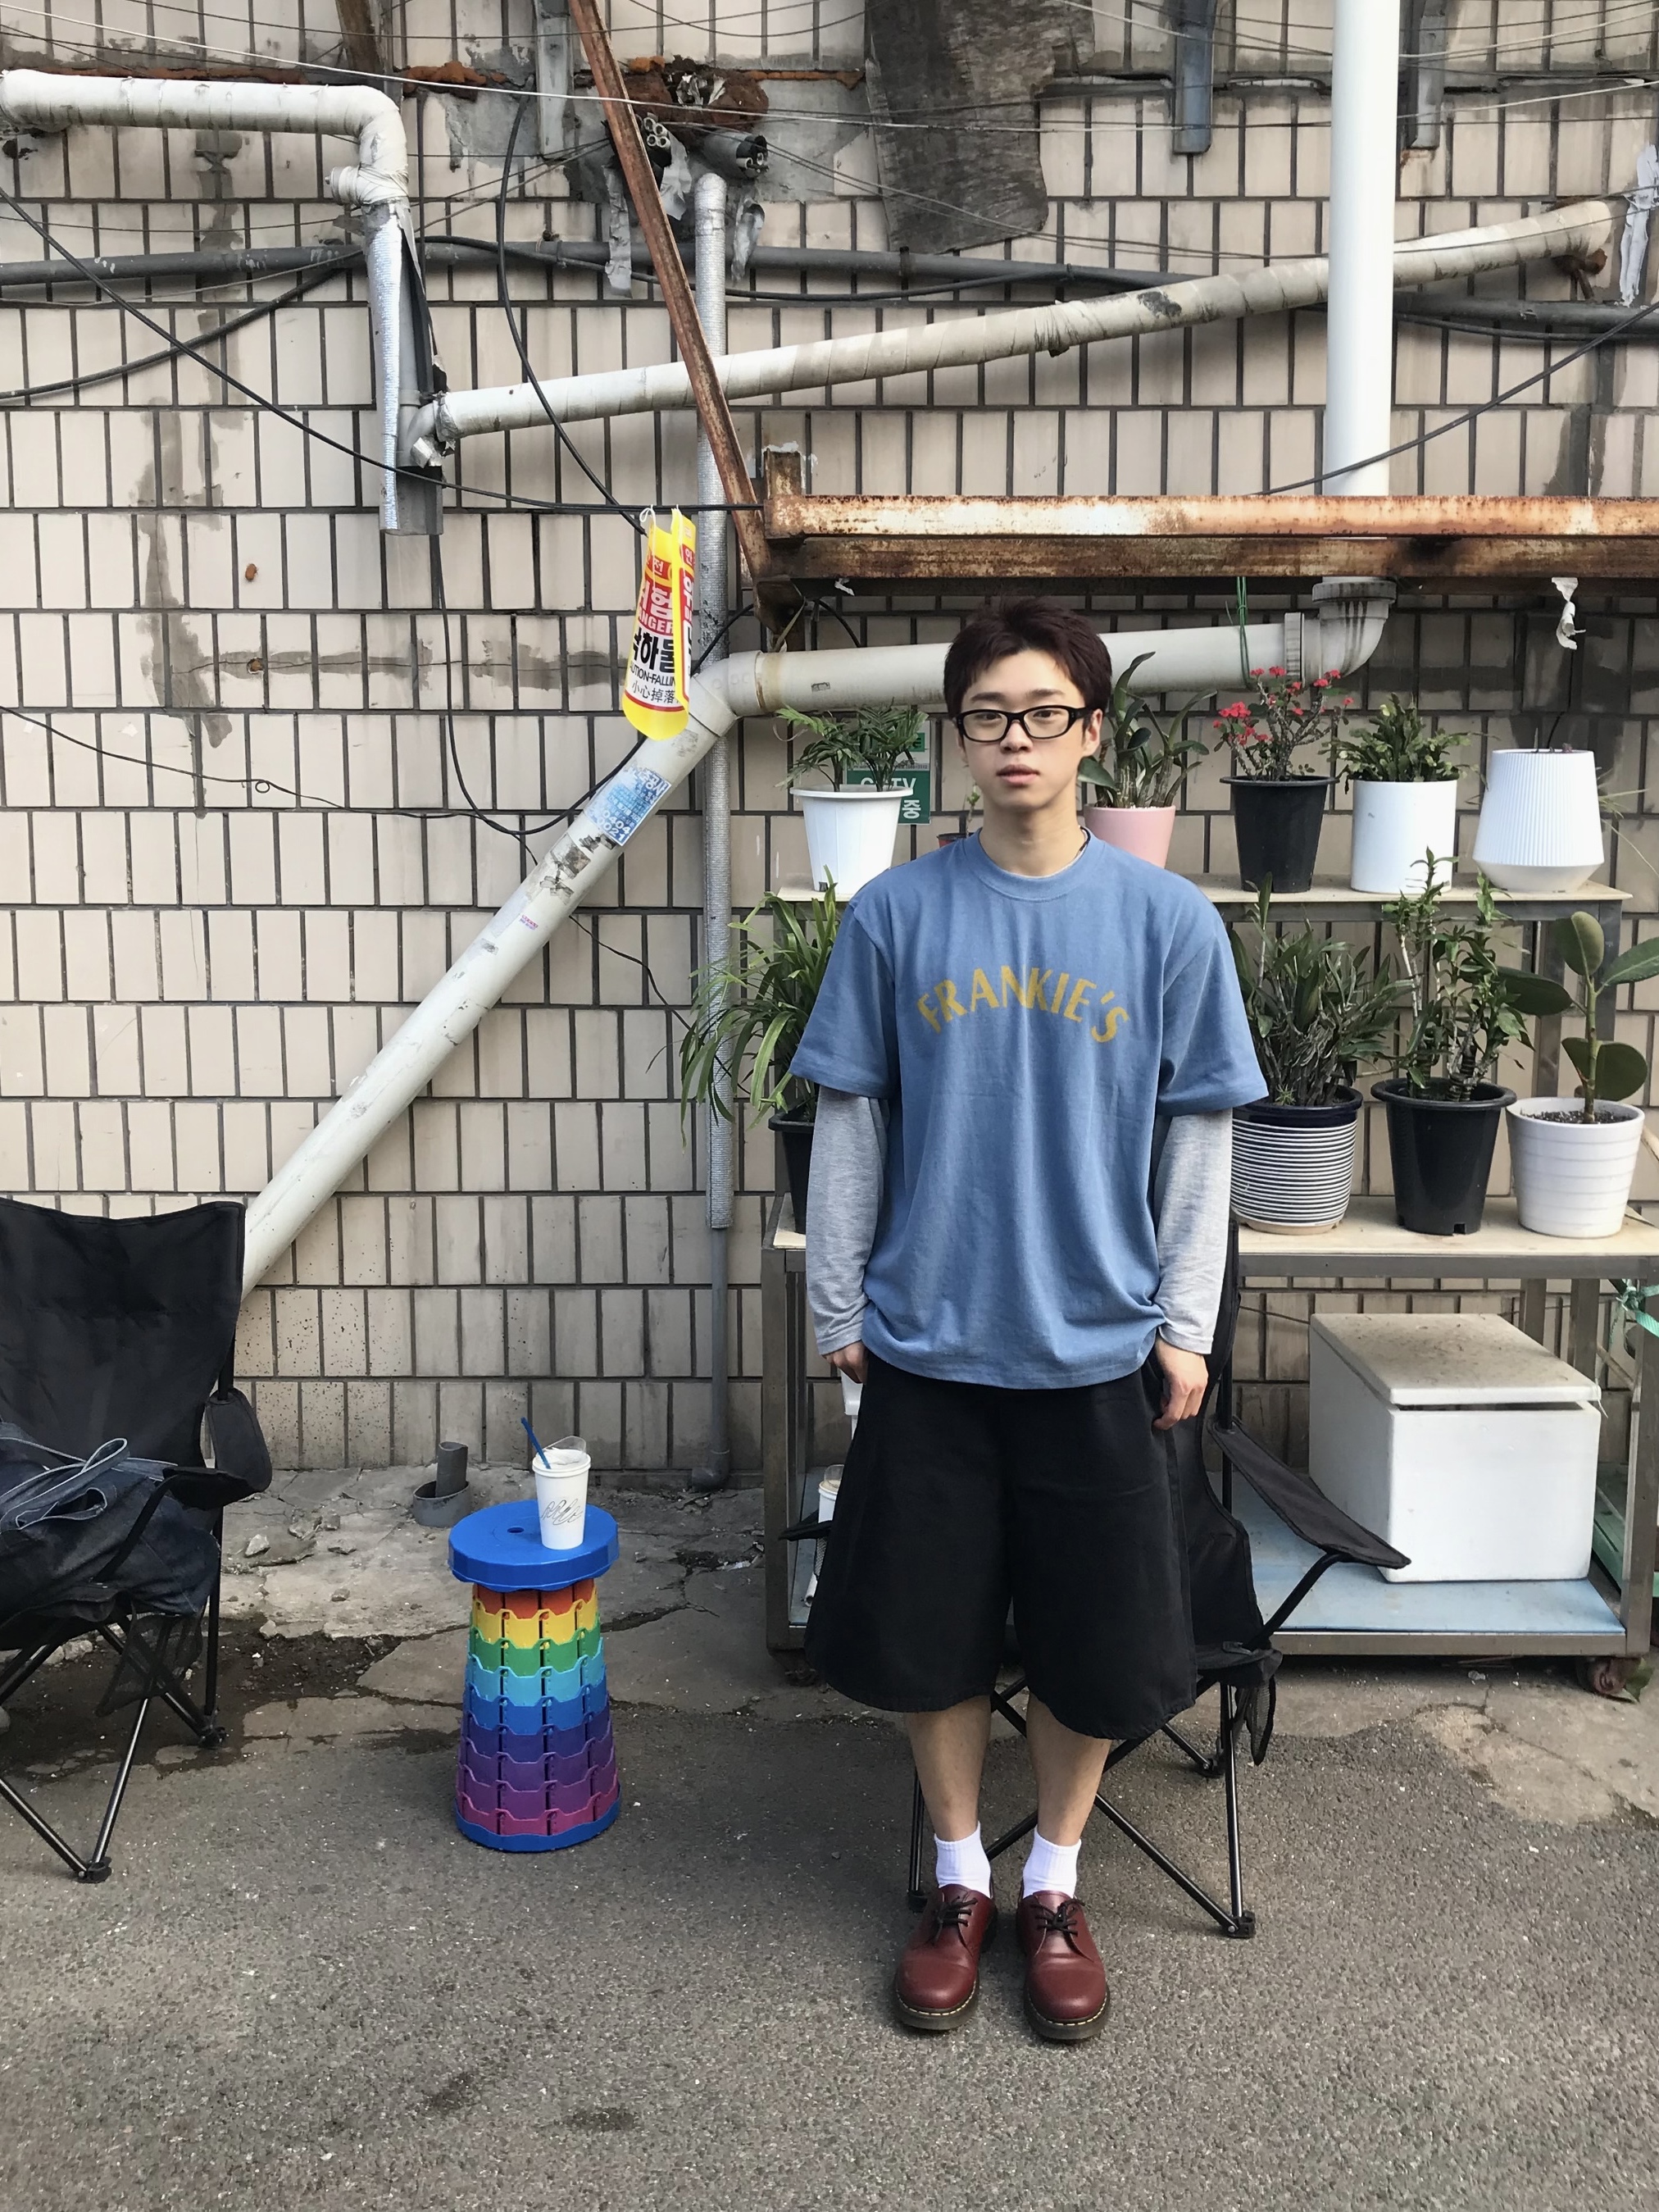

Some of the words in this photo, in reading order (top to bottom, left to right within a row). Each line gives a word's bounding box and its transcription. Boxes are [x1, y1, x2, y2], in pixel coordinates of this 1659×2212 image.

[632, 680, 679, 703] 小心掉落
[916, 965, 1130, 1043] FRANKIE'S
